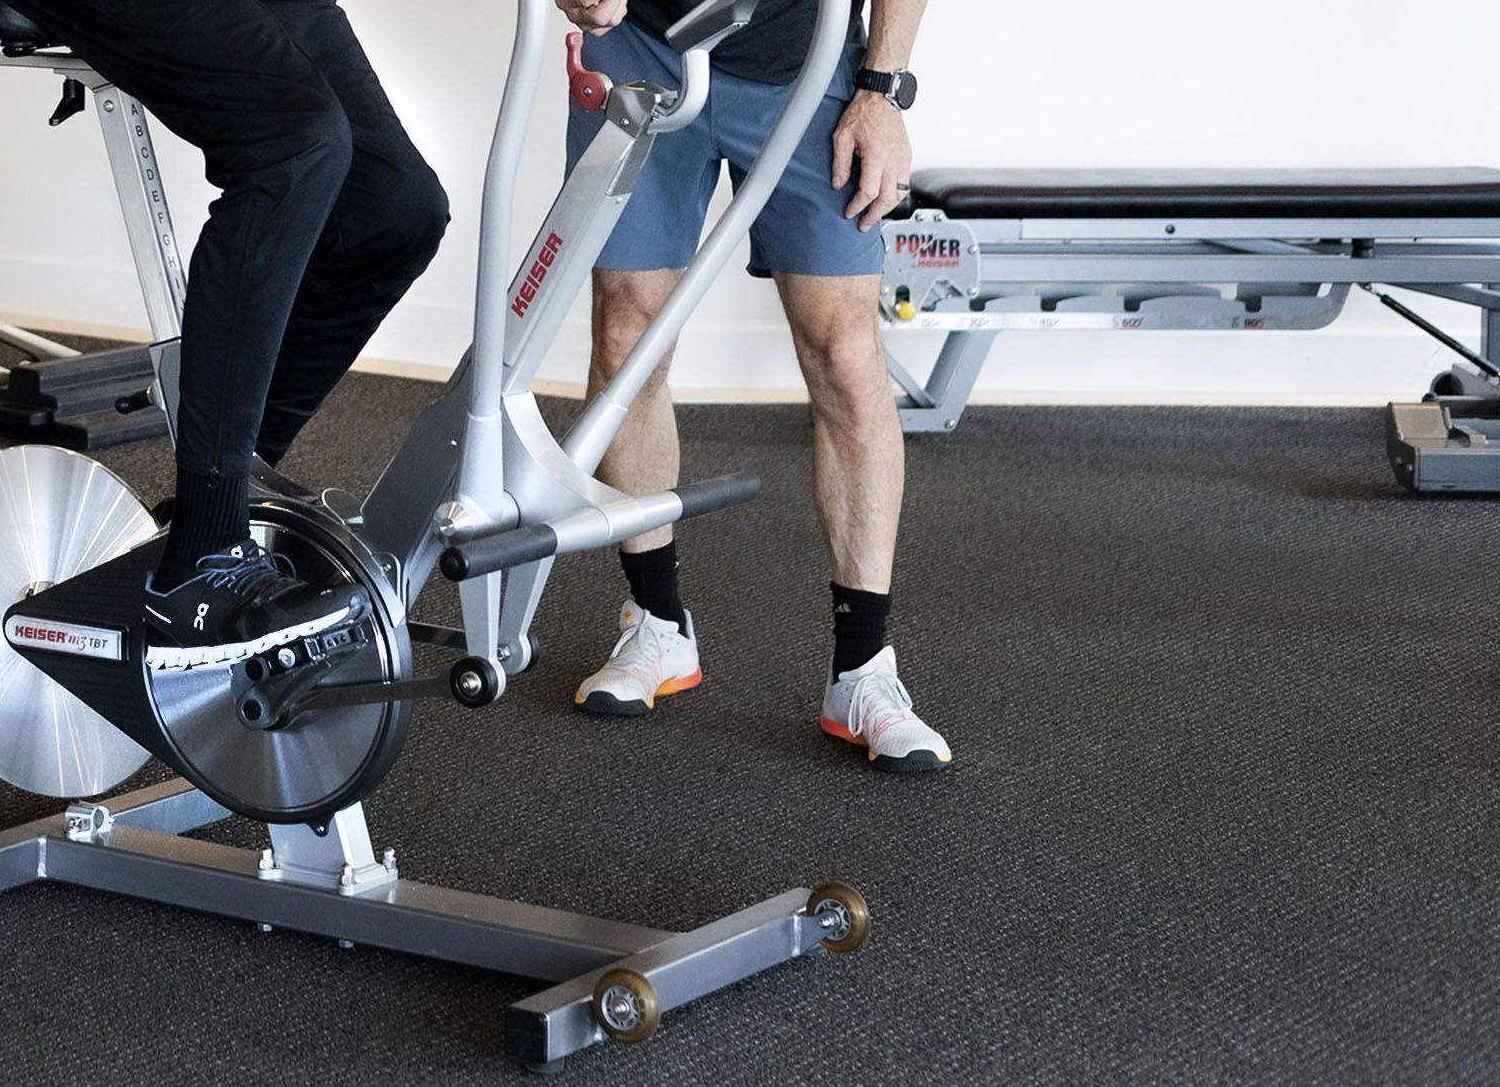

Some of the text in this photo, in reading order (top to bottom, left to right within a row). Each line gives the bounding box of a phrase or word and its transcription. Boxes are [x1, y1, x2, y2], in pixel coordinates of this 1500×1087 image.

[131, 104, 139, 115] A
[135, 125, 143, 137] B
[141, 147, 149, 159] C
[146, 169, 154, 181] D
[152, 190, 160, 202] E
[157, 212, 164, 224] F
[163, 234, 170, 246] G
[895, 233, 961, 258] POWER
[168, 256, 176, 268] H
[510, 231, 565, 319] KEISER
[13, 624, 67, 644] KEISER
[88, 637, 109, 649] TBT
